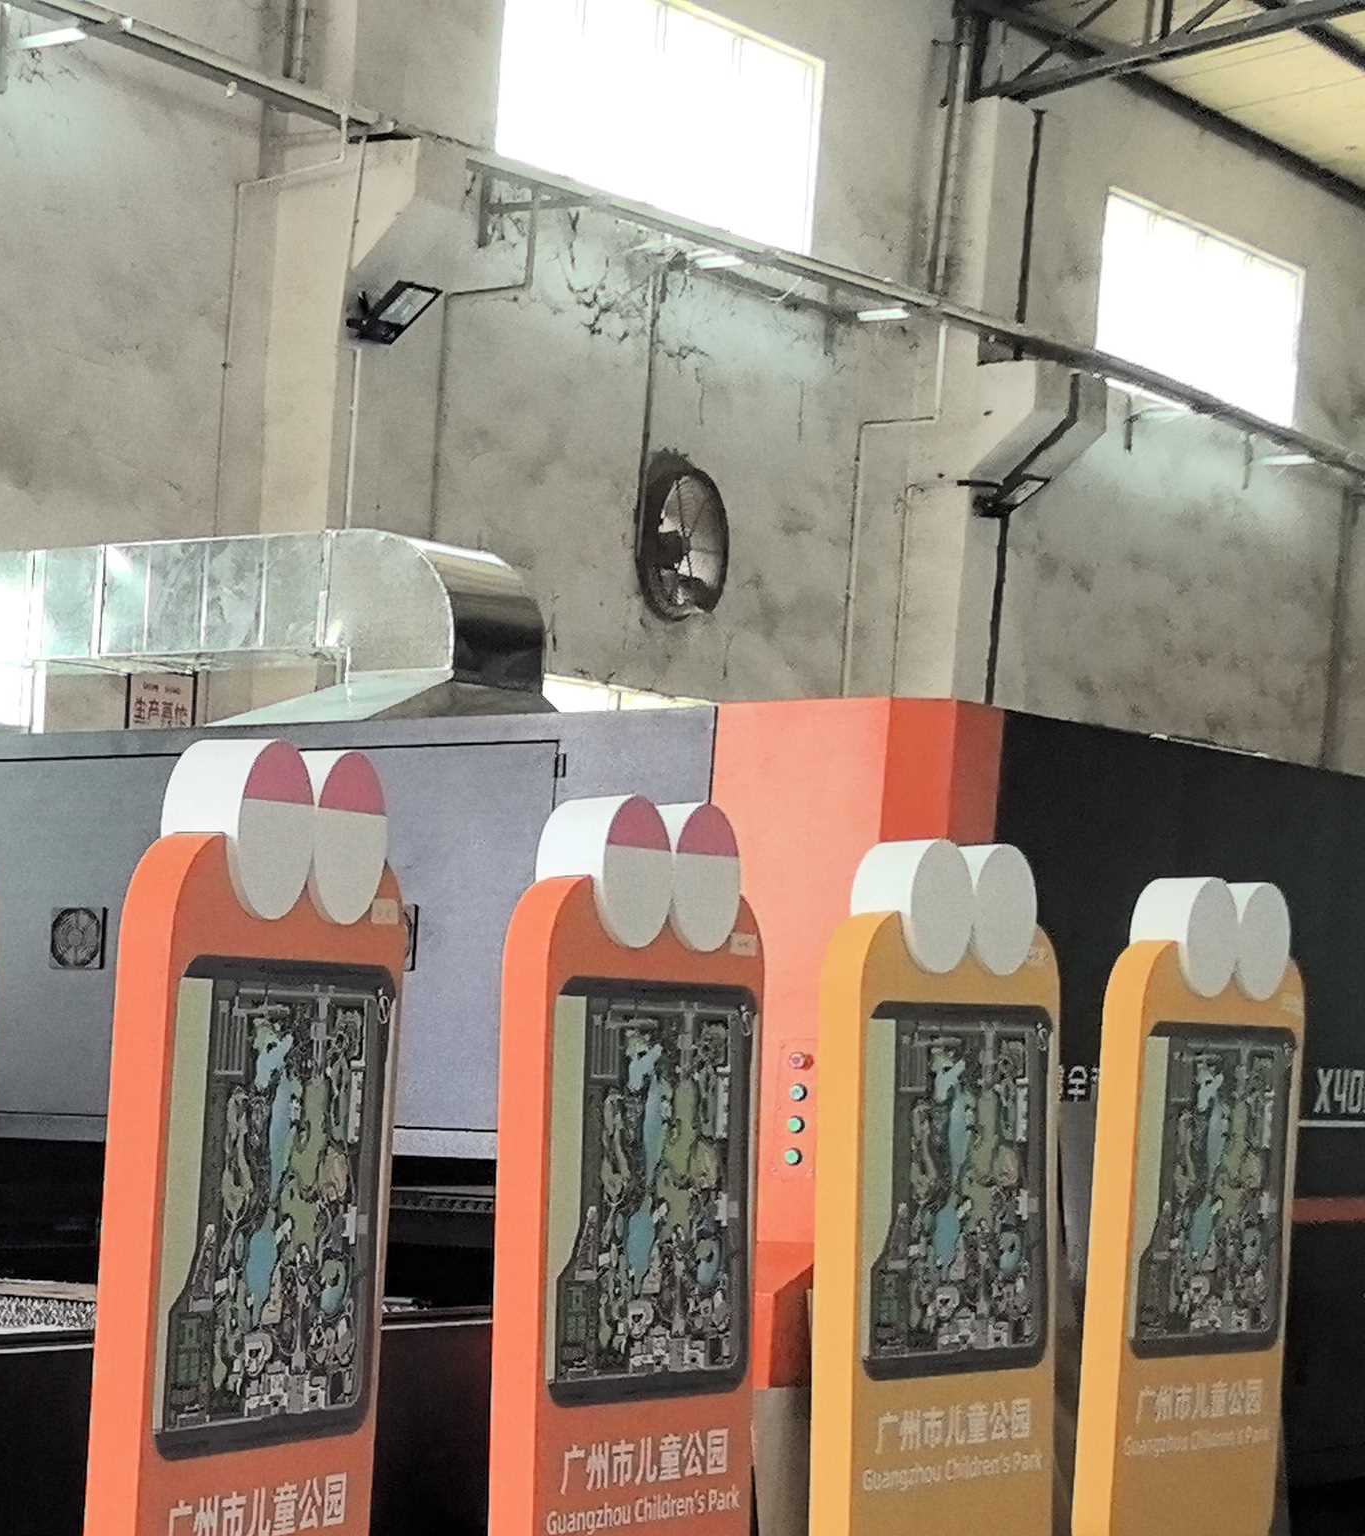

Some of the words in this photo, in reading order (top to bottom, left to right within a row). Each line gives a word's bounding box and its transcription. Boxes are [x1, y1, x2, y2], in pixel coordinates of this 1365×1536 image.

[560, 1428, 729, 1495] 广州市儿童公园
[546, 1503, 631, 1536] Guangzhou
[634, 1488, 704, 1523] Children's
[707, 1484, 741, 1513] Park
